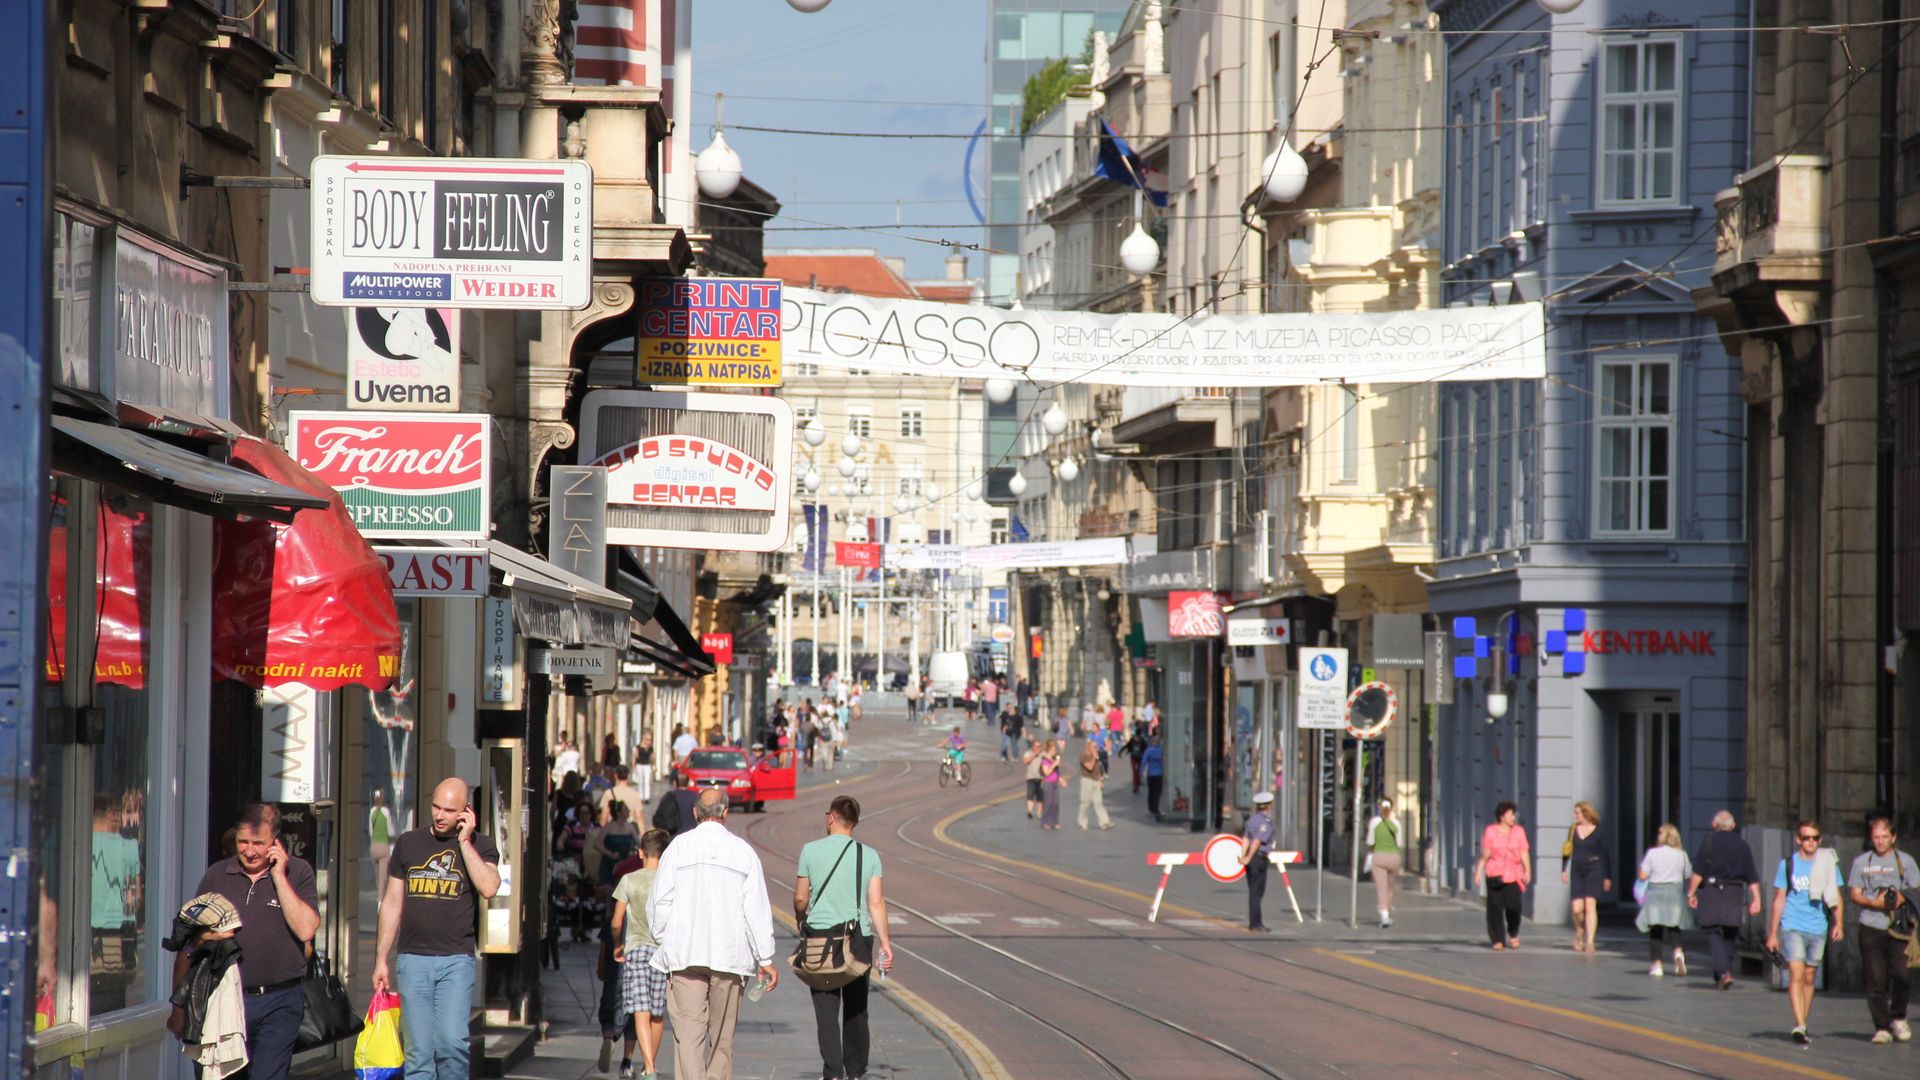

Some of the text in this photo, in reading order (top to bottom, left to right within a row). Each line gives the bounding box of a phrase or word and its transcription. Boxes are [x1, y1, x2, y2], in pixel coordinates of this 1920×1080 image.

[325, 177, 334, 257] SPORTSKA
[352, 188, 427, 249] BODY
[393, 262, 512, 273] NADOPUNA PREHRANI
[350, 274, 556, 297] MULTIPOWER WEIDER
[642, 281, 779, 307] PRINT
[642, 311, 778, 337] CENTAR
[660, 341, 760, 357] POZIVNICE
[1053, 326, 1195, 349] REMEK-DJELA
[1204, 330, 1226, 349] IZ
[1236, 328, 1320, 349] MUZEJA
[355, 360, 421, 377] Estetic
[648, 361, 771, 379] IZRADA NATPISA
[354, 380, 450, 403] Uvema
[300, 426, 481, 475] Franck
[592, 439, 774, 491] OTO STUDIO
[655, 466, 714, 482] digital
[633, 483, 736, 506] CENTAR
[345, 505, 453, 524] SPRESSO
[378, 554, 483, 591] RAST
[494, 600, 504, 699] TOKOPIRANJE
[1583, 629, 1715, 655] KENTBANK
[234, 663, 363, 677] modni nakit
[548, 657, 602, 668] ODVJETNIK
[409, 878, 458, 897] VINYL
